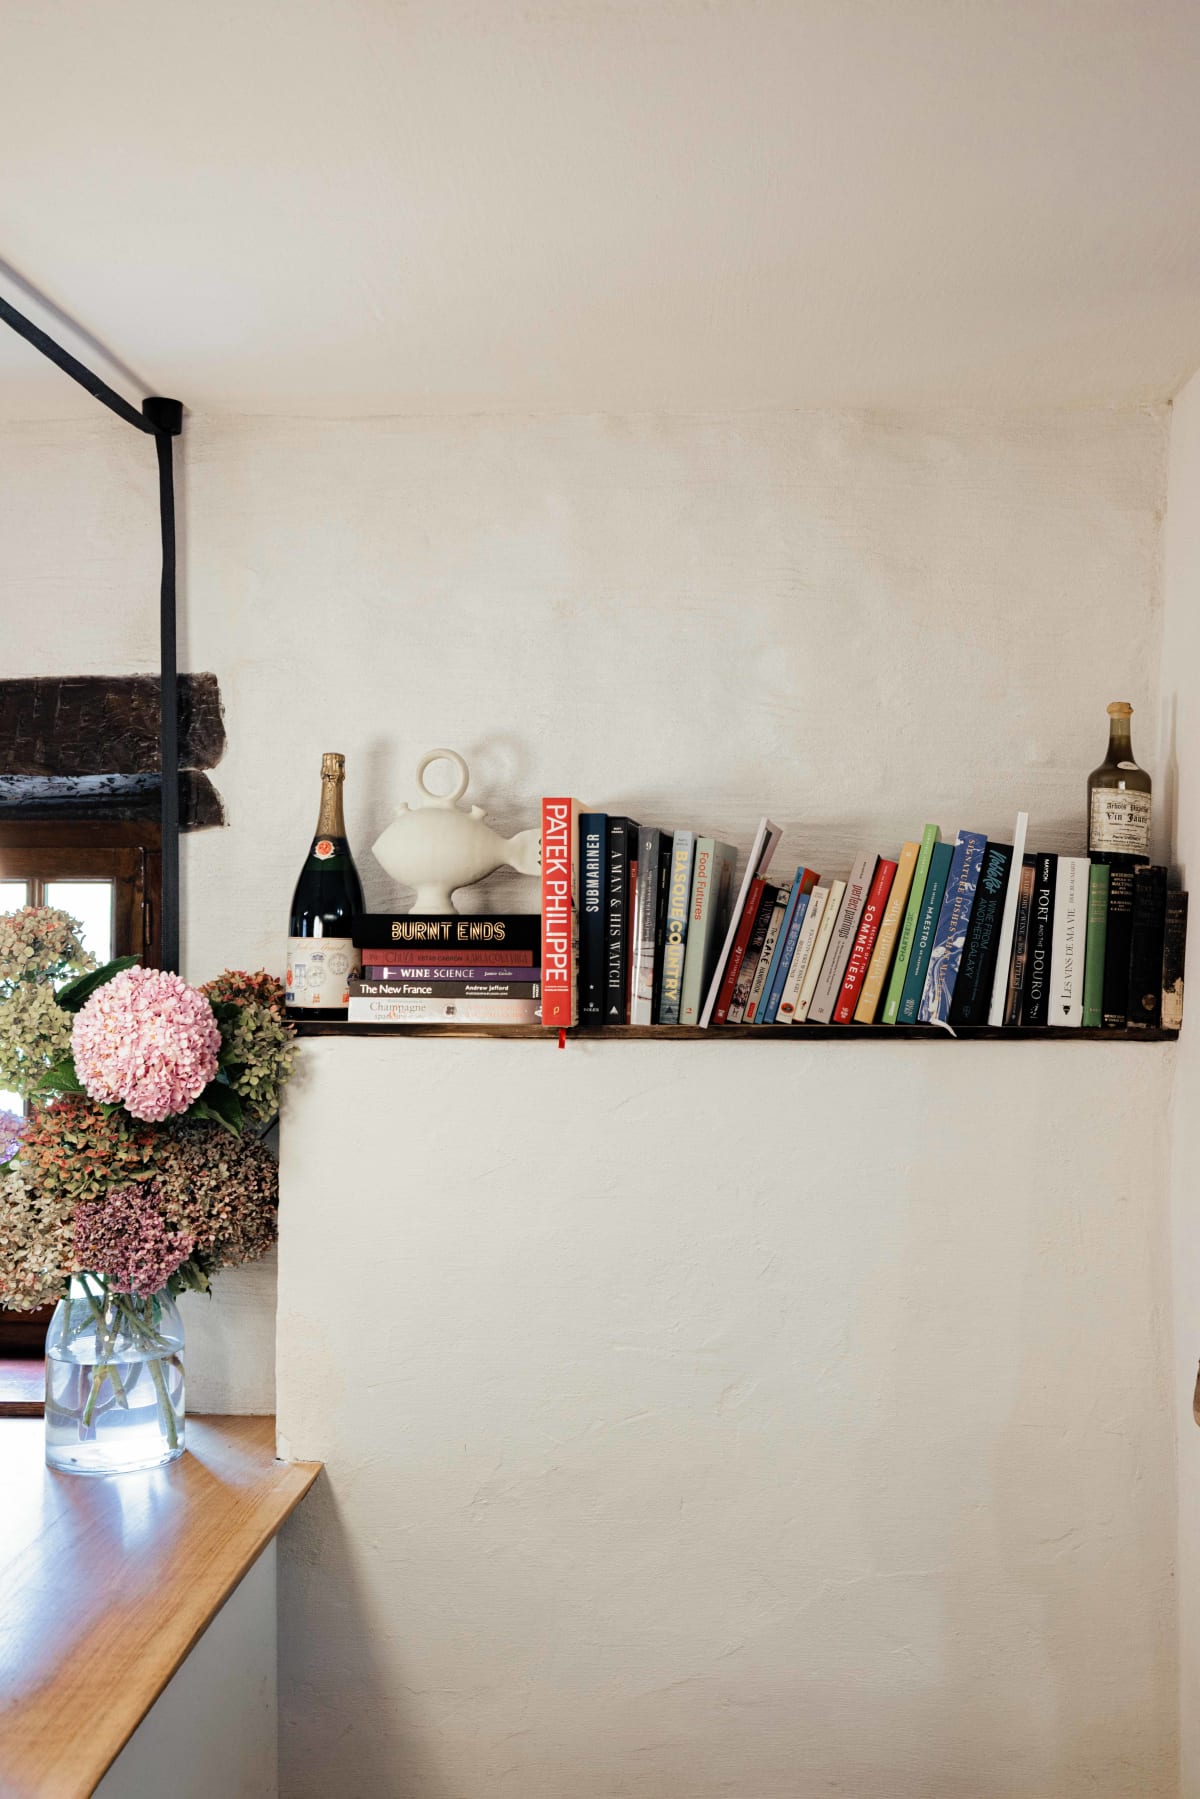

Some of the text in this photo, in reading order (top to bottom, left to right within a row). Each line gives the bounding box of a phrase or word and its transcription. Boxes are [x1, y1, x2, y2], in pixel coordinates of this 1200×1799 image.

[1106, 812, 1122, 821] Vin
[586, 834, 600, 912] SUBMARINER
[672, 851, 688, 918] BASQUE
[957, 839, 975, 893] SIGNATURE
[1042, 858, 1050, 882] MAYSON
[546, 805, 567, 981] PATEK PHILIPPE
[694, 852, 709, 920] Food Futures
[1037, 889, 1050, 922] PORT
[392, 921, 506, 941] BURNT ENDS
[609, 850, 623, 988] A MAN & HIS WATCH
[839, 885, 863, 939] perfect pairings
[882, 899, 901, 927] Wine
[920, 906, 934, 948] MAESTRO
[949, 896, 963, 932] DISHES
[971, 898, 984, 941] ANOTHER
[980, 901, 997, 950] WINE FROM
[1067, 908, 1076, 923] VIE
[844, 905, 876, 990] SOMMELIERS
[898, 911, 914, 962] CHARTREUSE
[1066, 926, 1075, 941] MA
[1066, 943, 1074, 955] DE
[400, 968, 475, 978] WINE SCIENCE
[666, 921, 683, 1000] COUNTRY
[965, 942, 979, 979] GALAXY
[1031, 950, 1045, 1000] DOURO
[1064, 958, 1073, 980] VINS
[360, 984, 433, 994] The New France
[370, 1001, 427, 1013] Champagne
